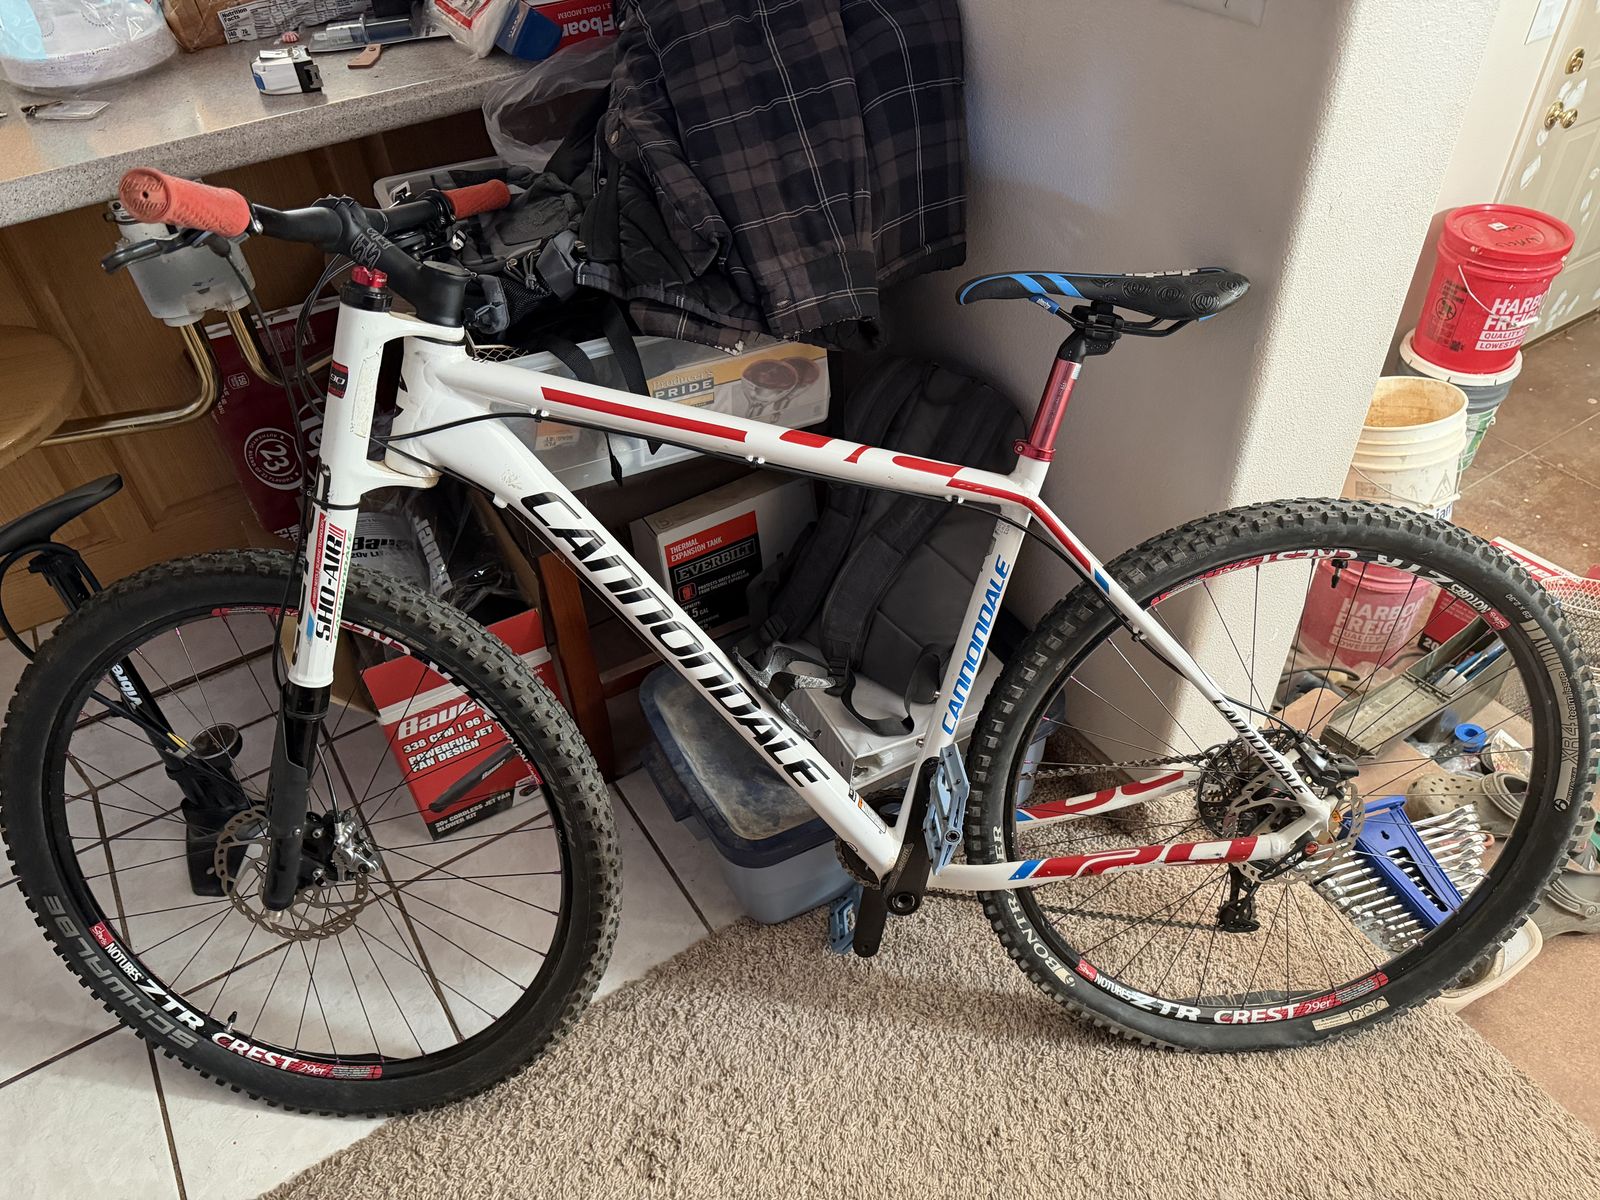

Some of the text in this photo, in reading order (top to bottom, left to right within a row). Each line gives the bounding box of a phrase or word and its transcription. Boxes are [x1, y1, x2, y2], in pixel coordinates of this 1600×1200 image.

[222, 8, 248, 18] Nutrition
[224, 15, 240, 23] Facts
[558, 7, 582, 20] MODEM
[1480, 340, 1515, 350] LOWEST
[1484, 331, 1520, 341] QUALITY
[655, 379, 714, 401] PRIDE
[259, 444, 290, 472] 23
[670, 538, 699, 554] THERMAL
[671, 536, 723, 562] EXPANSION TANK
[678, 543, 753, 581] EVERBILT
[316, 535, 342, 641] SHO-AIR
[404, 738, 426, 754] 338
[429, 726, 455, 744] CFM
[465, 717, 481, 730] 96
[408, 724, 494, 765] POWERFUL JET
[1561, 722, 1579, 764] XR4
[438, 740, 480, 763] DESIGN
[437, 812, 478, 833] BLOWER KIT
[449, 803, 483, 821] CORDLESS
[43, 895, 200, 1050] SCHWALBE
[105, 942, 143, 983] NOTUBES
[135, 978, 205, 1031] ZTR
[211, 1032, 302, 1071] CREST
[299, 1061, 327, 1077] 29er
[1094, 973, 1131, 1001] NOTUBES
[1129, 992, 1202, 1021] ZTR
[1213, 1003, 1302, 1025] CREST
[1304, 997, 1331, 1014] 29er
